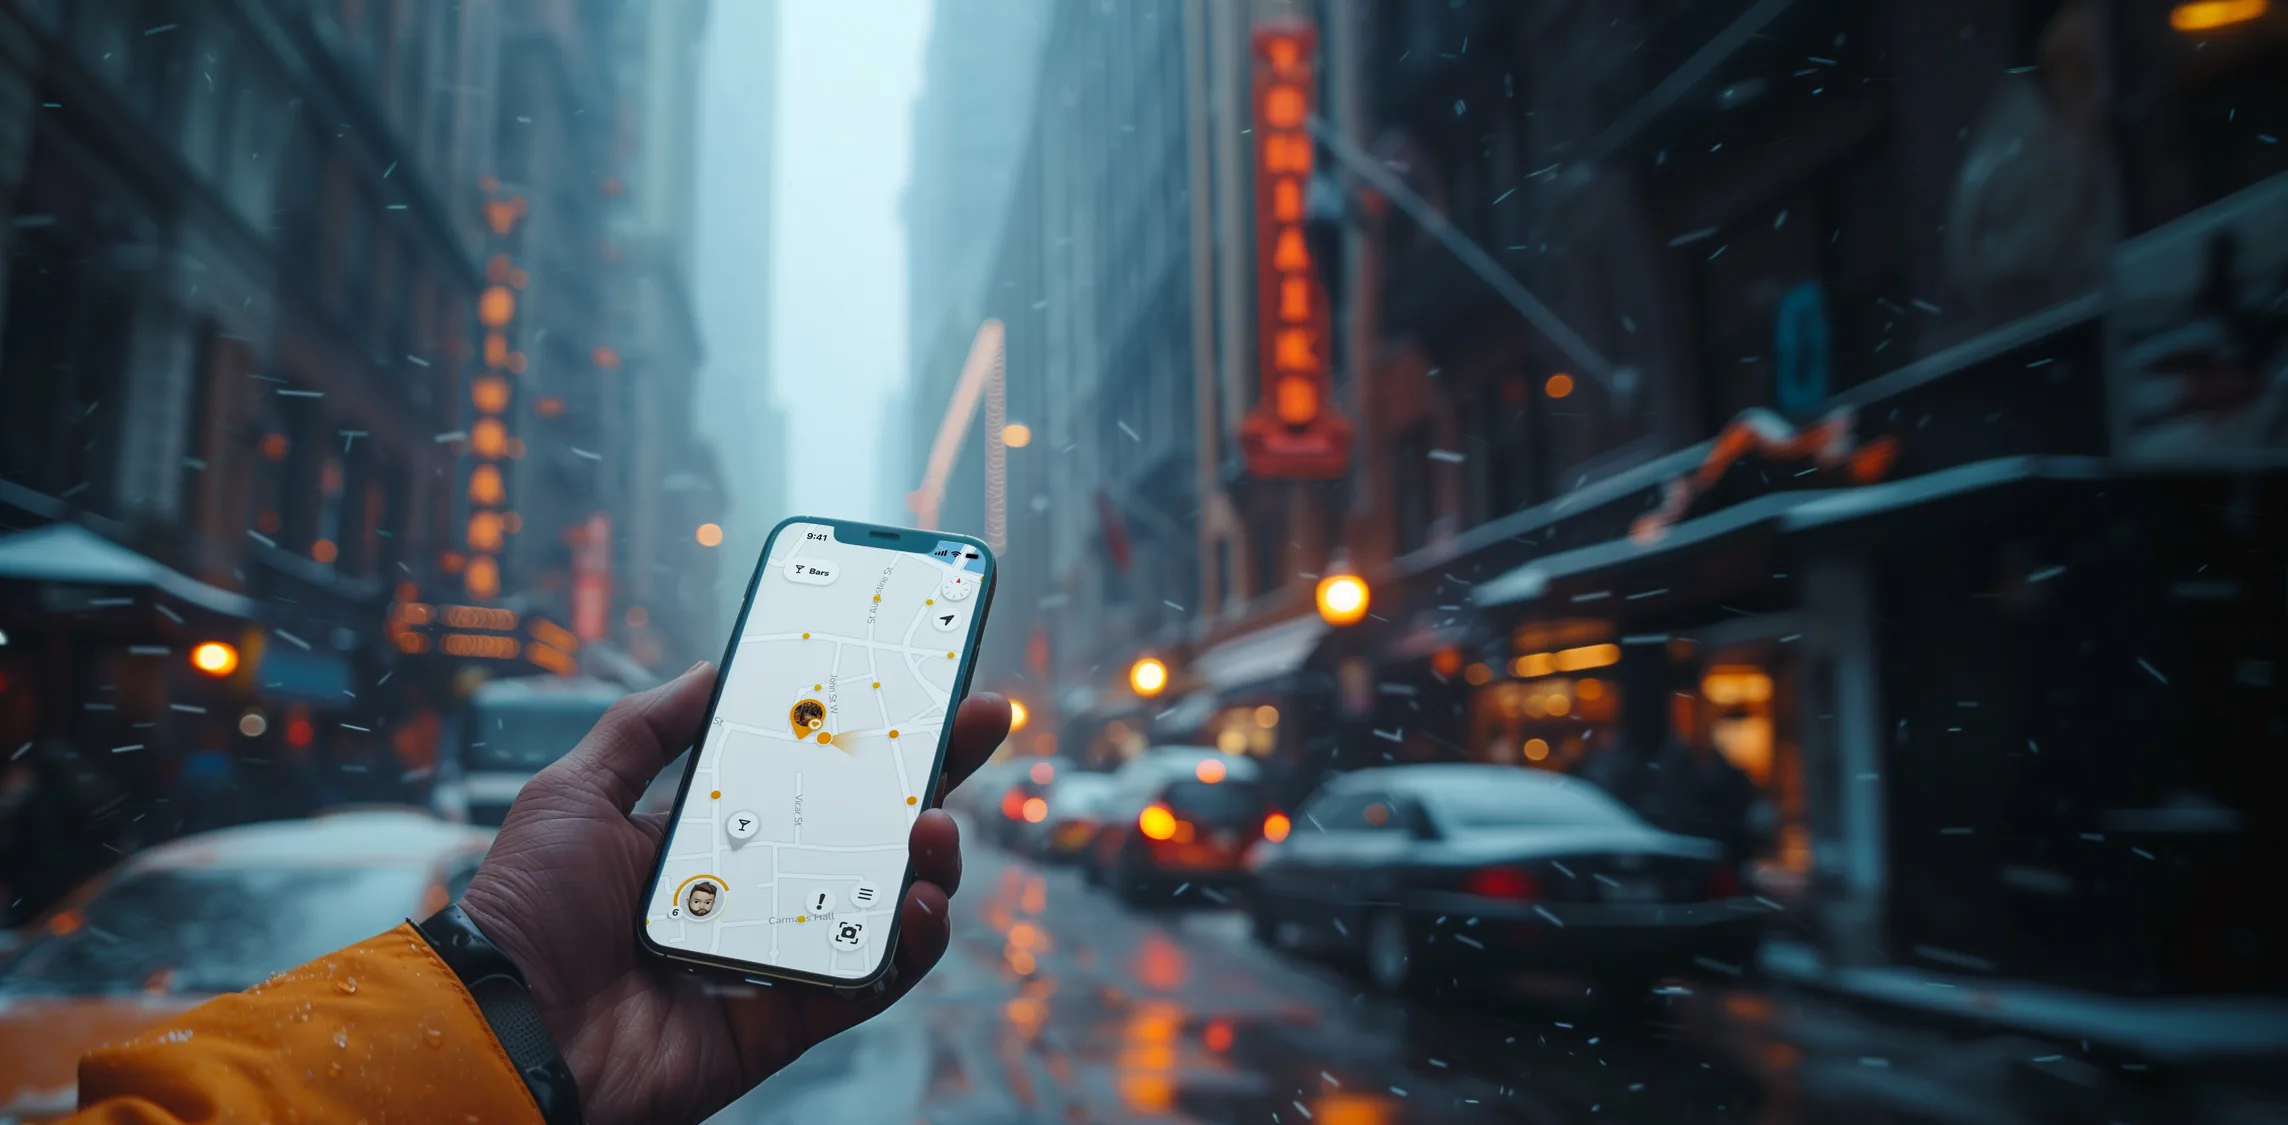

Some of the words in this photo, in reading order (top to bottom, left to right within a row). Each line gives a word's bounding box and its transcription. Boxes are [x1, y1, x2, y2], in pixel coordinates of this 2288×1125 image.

[807, 532, 828, 542] 9:41
[809, 567, 830, 577] Bars
[883, 567, 894, 576] St
[869, 576, 889, 615] Austine
[867, 616, 876, 624] St
[829, 674, 838, 693] John
[829, 694, 838, 704] St
[830, 704, 839, 715] W
[712, 716, 725, 727] St
[795, 793, 804, 816] Vicar
[794, 817, 803, 826] St
[672, 908, 680, 917] 6
[768, 915, 812, 925] Carmas
[814, 911, 835, 922] Hall
